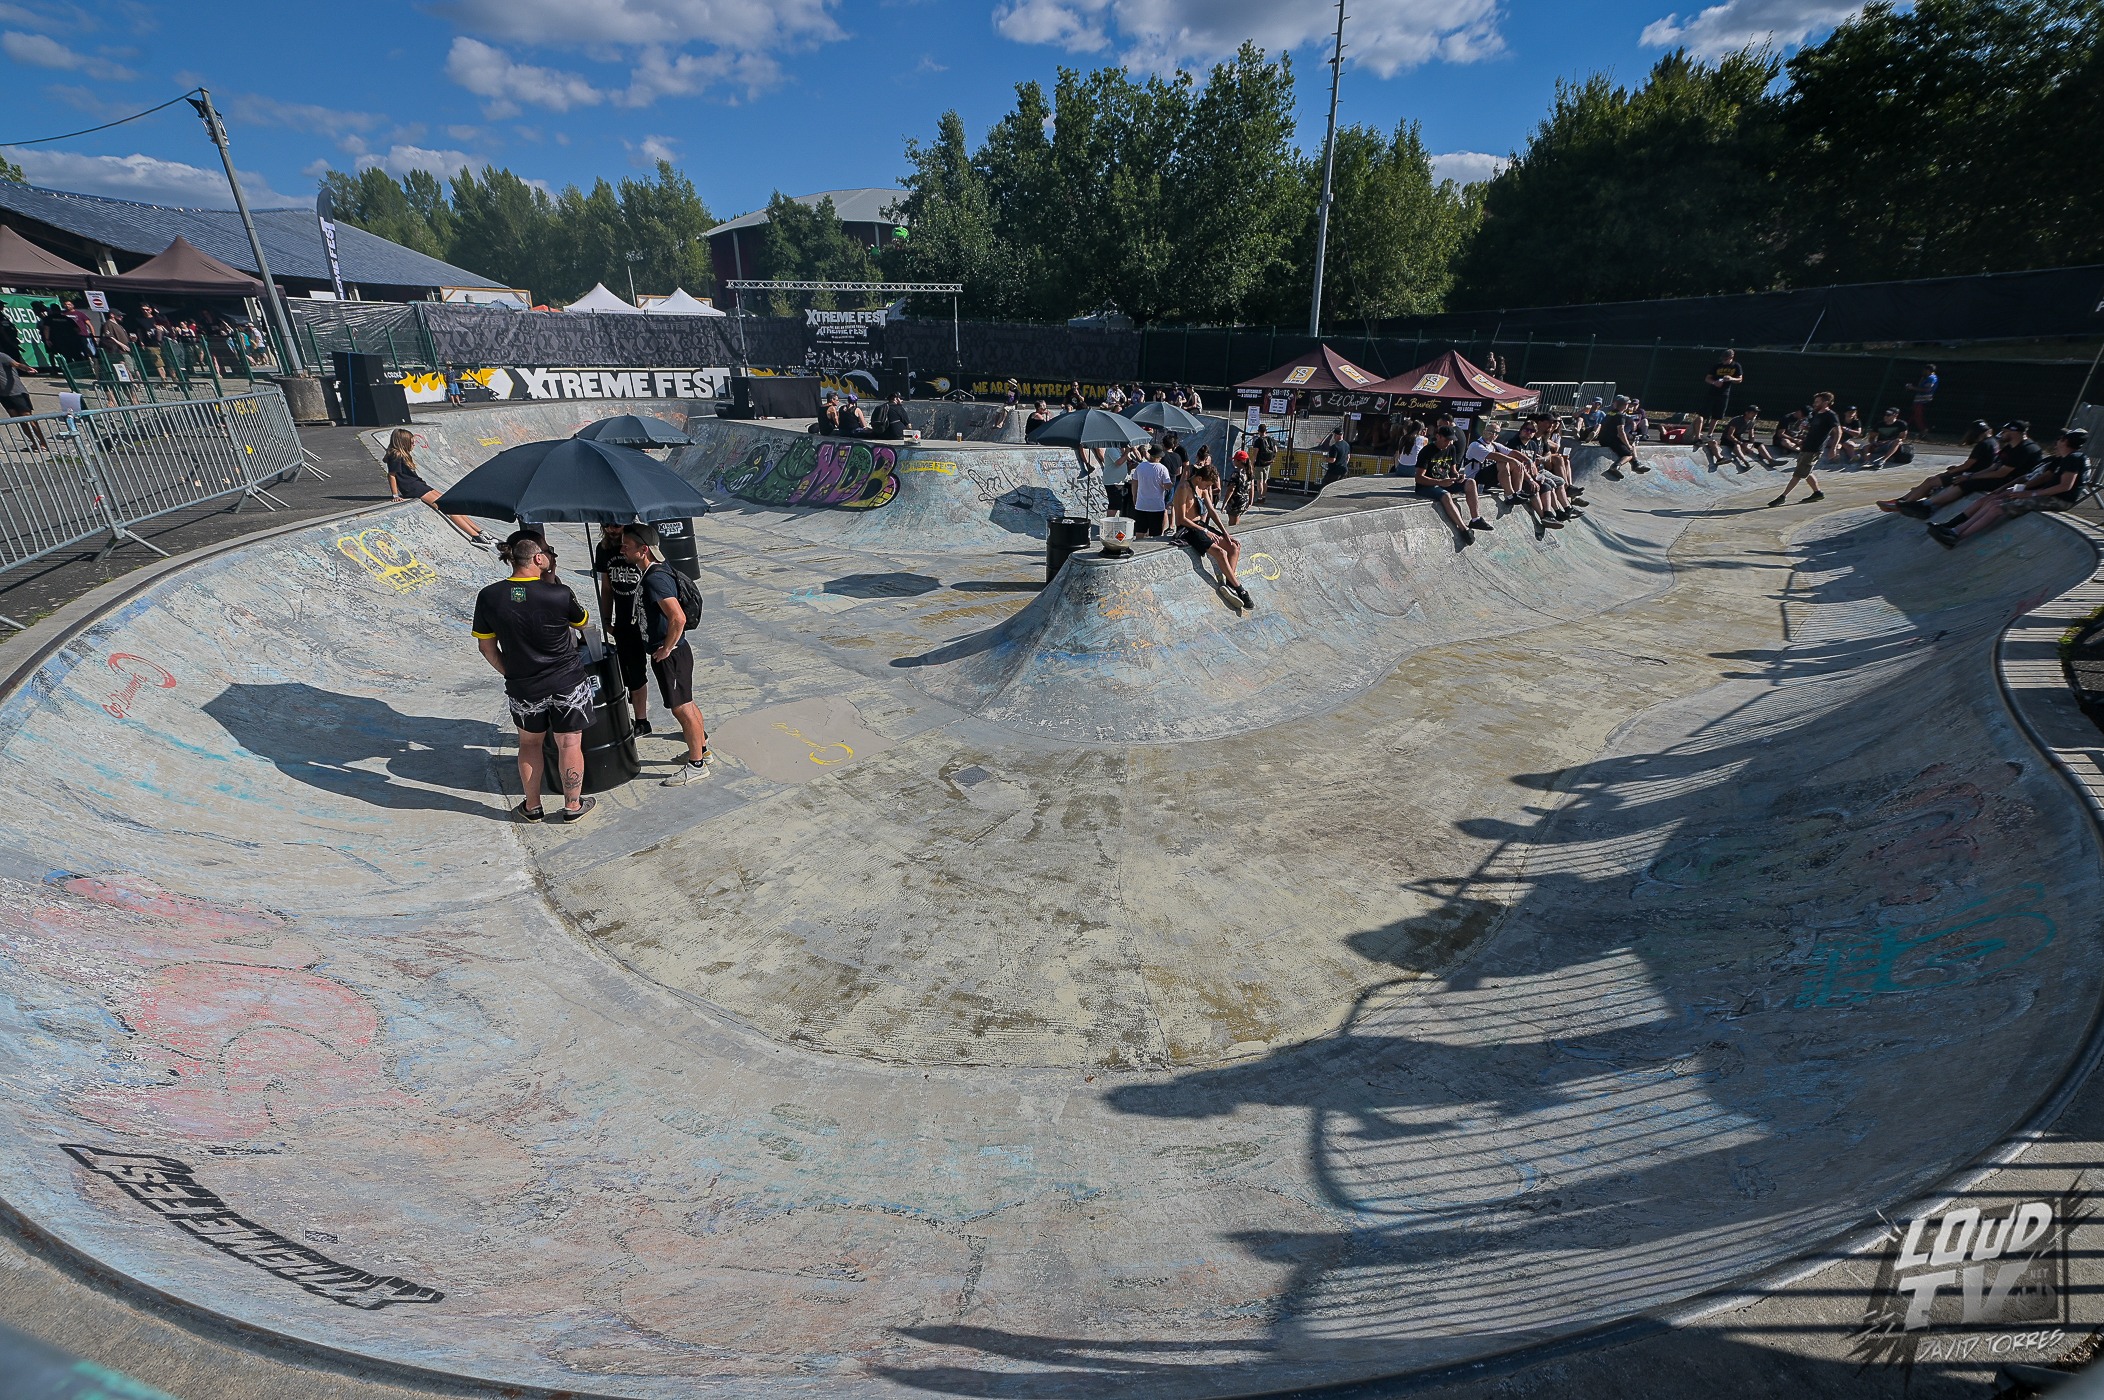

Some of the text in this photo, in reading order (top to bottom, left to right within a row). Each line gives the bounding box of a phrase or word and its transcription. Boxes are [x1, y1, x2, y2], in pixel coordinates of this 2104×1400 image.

[805, 309, 888, 329] XTREME FEST
[515, 368, 731, 399] XTREME FEST
[971, 382, 989, 395] WE
[1033, 382, 1071, 397] XTREM
[1394, 397, 1407, 407] La
